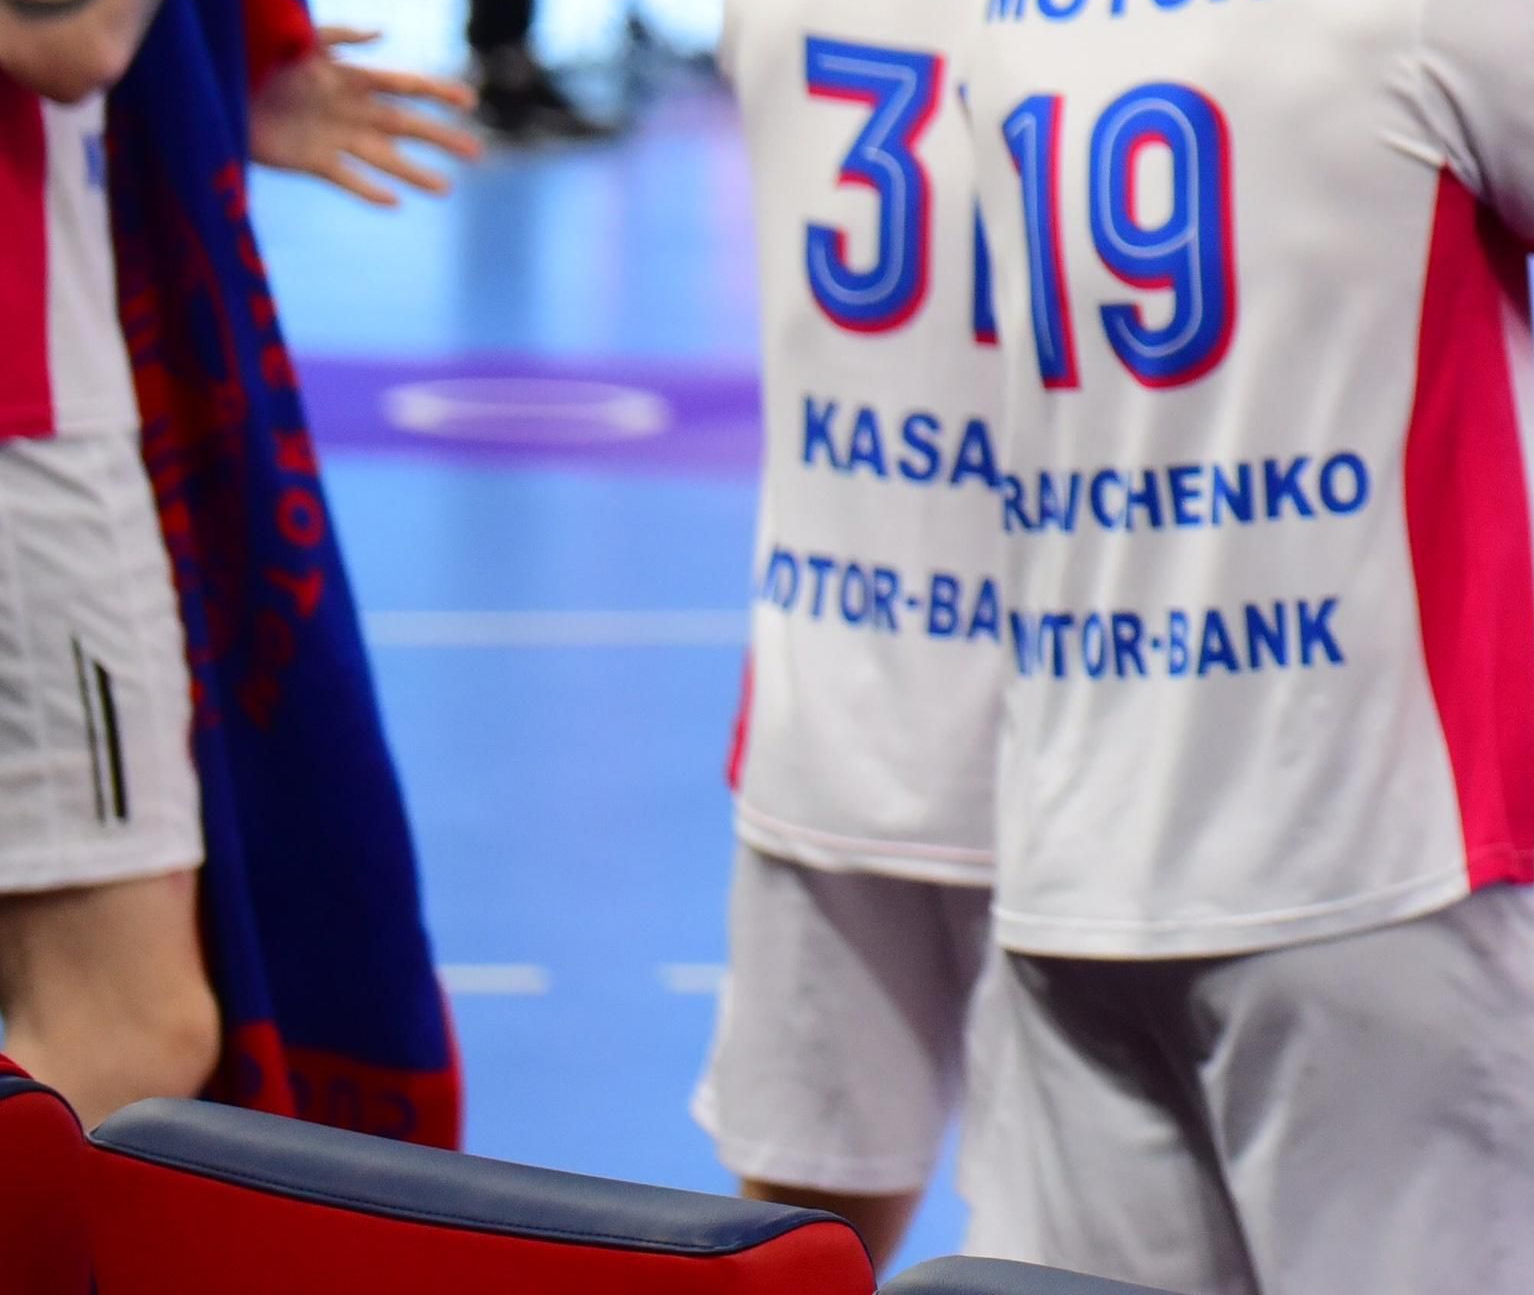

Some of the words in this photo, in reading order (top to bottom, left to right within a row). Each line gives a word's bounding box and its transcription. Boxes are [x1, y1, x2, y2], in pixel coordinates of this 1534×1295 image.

[804, 34, 1000, 346] 3
[1003, 81, 1240, 390] 19
[802, 396, 1001, 489] KASA
